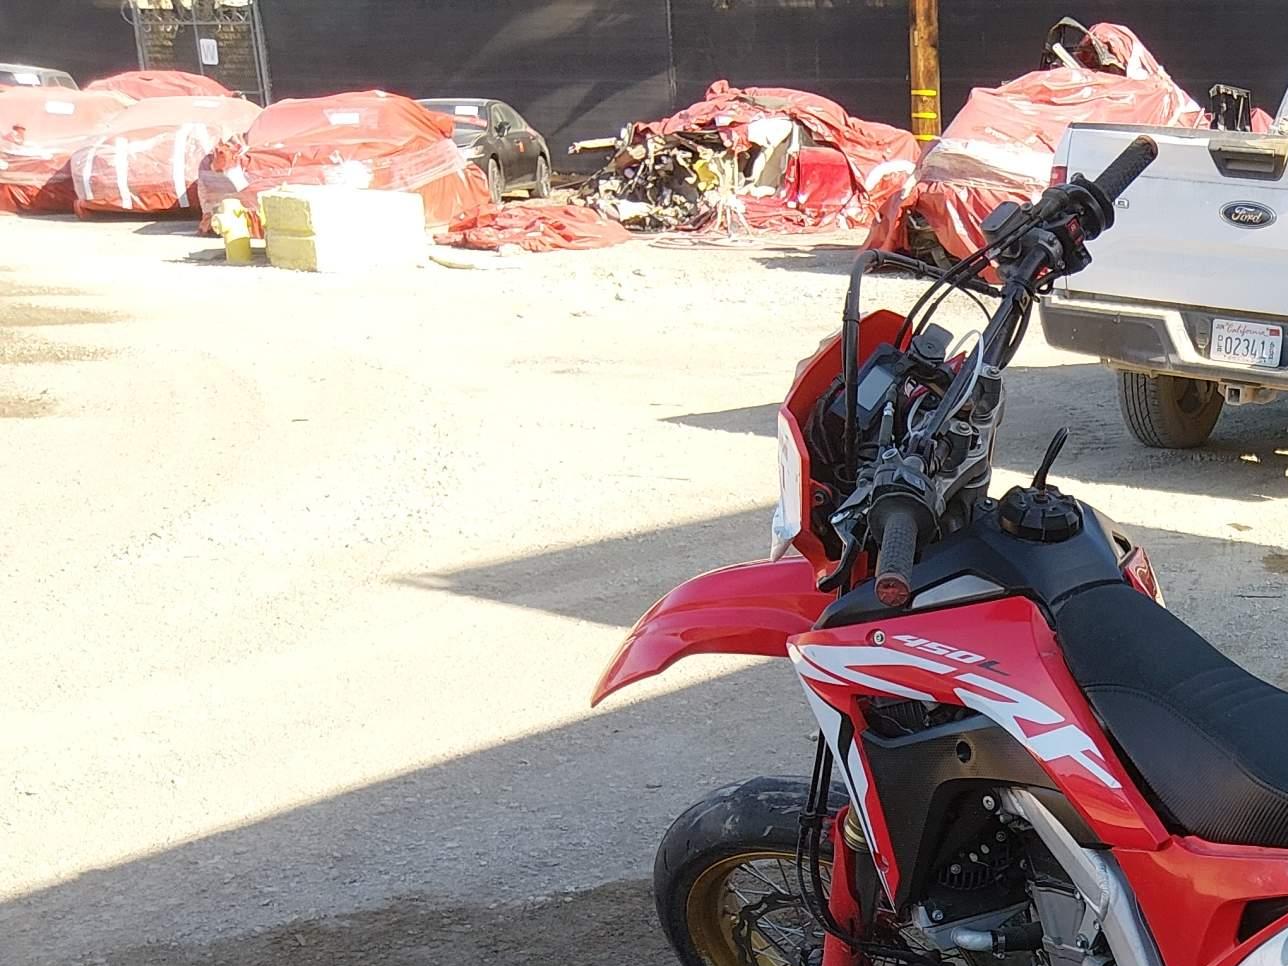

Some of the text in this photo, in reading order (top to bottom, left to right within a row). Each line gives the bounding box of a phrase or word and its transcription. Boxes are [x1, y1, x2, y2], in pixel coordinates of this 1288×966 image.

[1230, 206, 1263, 225] Ford
[1226, 323, 1266, 336] California
[1224, 336, 1266, 360] 02341
[891, 634, 1010, 677] 450L
